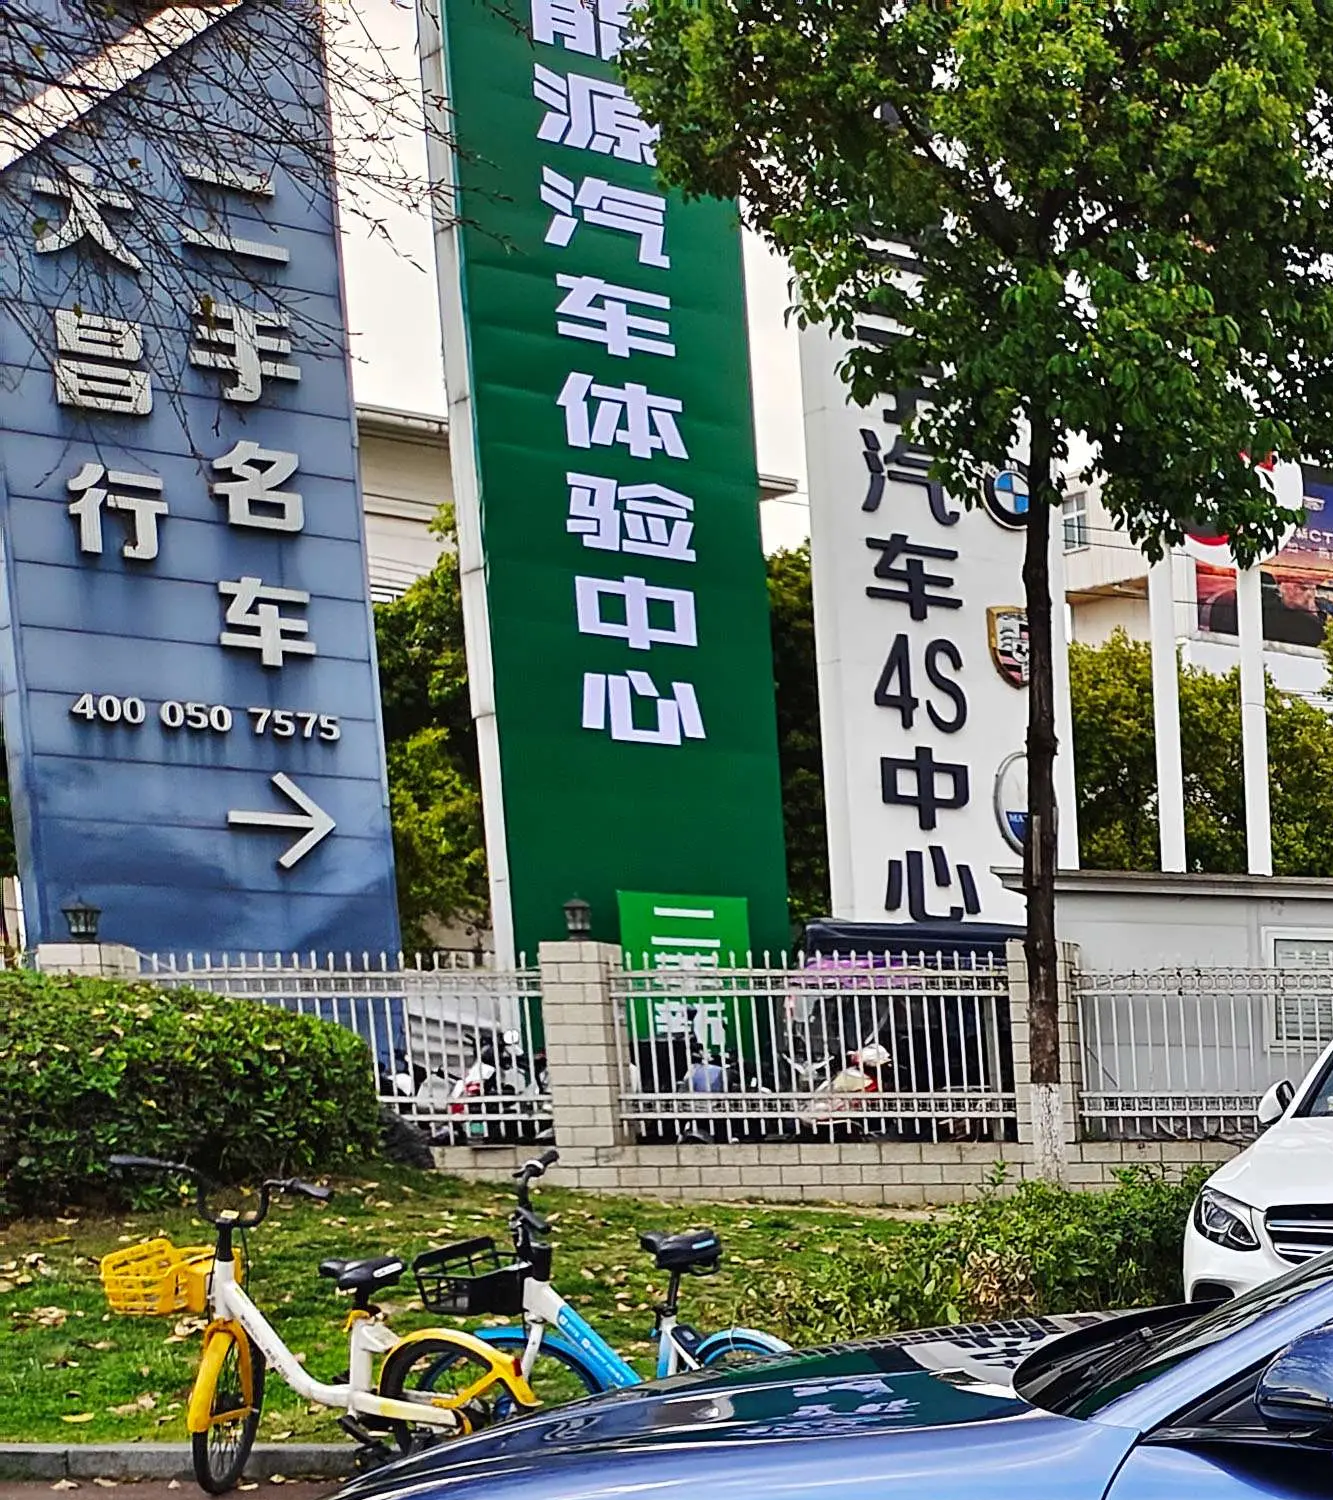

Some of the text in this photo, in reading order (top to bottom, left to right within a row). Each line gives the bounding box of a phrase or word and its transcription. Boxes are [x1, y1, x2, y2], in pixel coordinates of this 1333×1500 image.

[30, 164, 170, 560] 大昌行
[180, 163, 317, 667] 二手名车
[71, 693, 342, 742] 400 050 7575
[860, 388, 982, 923] 汽车4S中心
